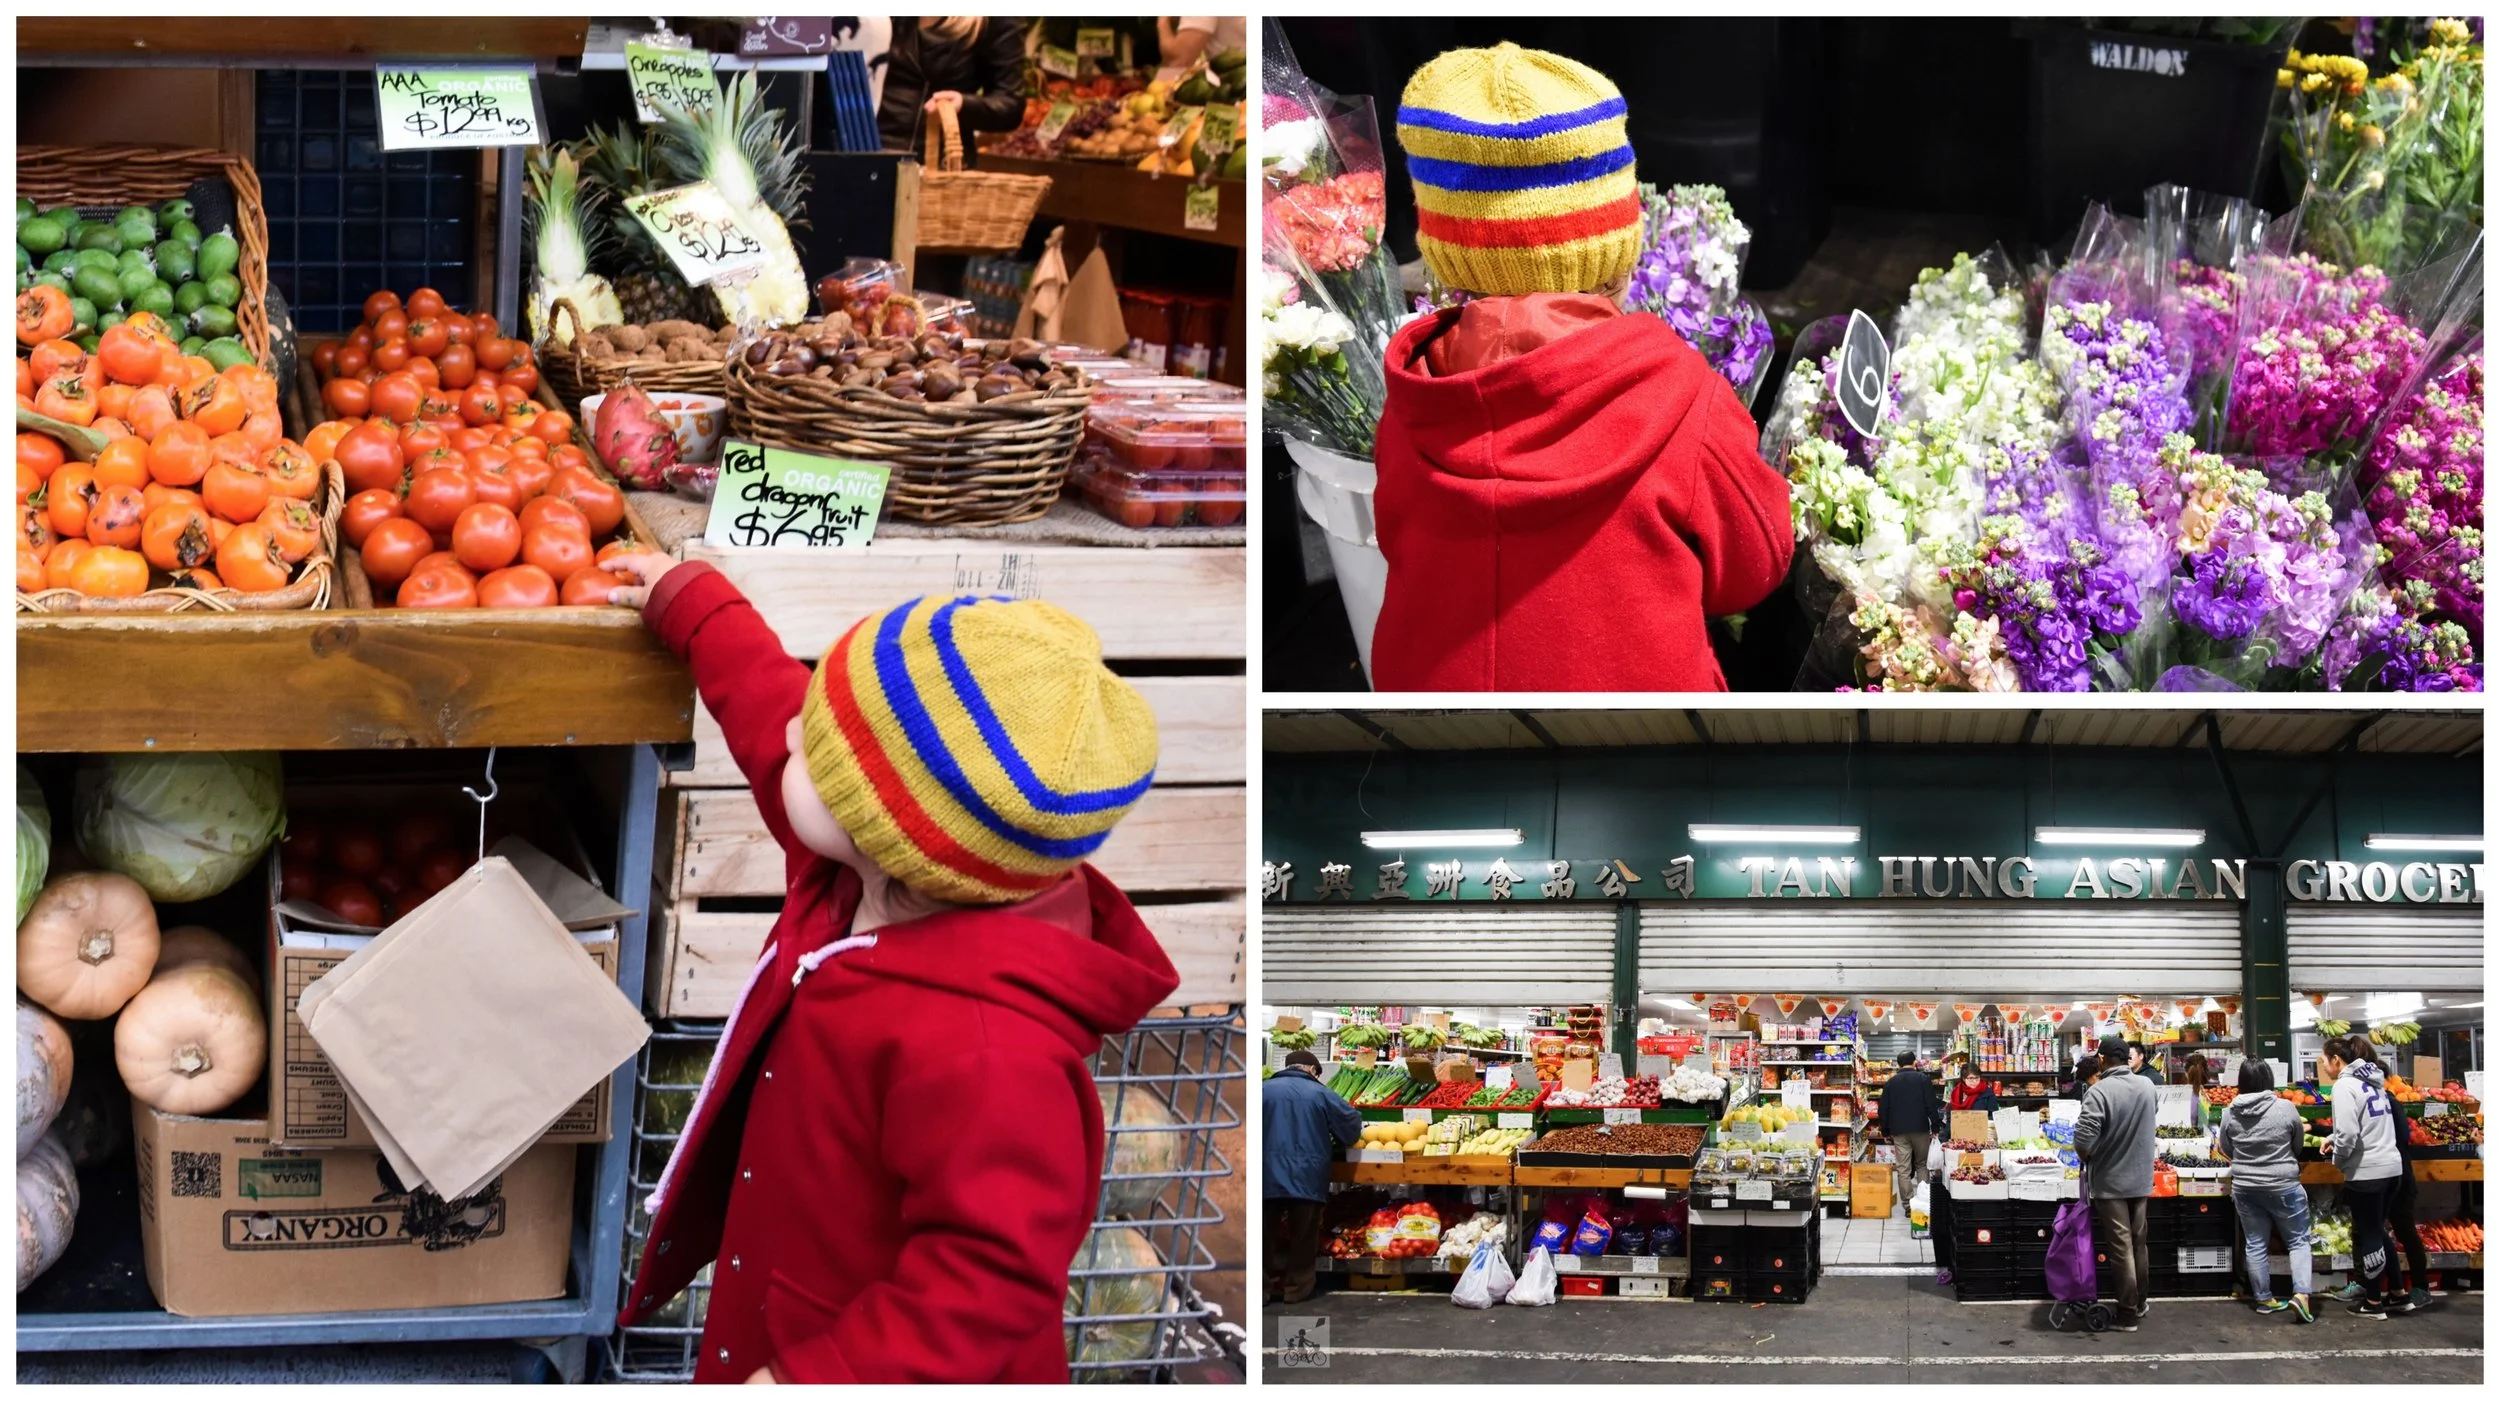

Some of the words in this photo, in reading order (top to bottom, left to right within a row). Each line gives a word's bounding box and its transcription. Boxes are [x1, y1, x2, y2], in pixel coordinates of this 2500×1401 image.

[2090, 42, 2188, 77] WALDON
[381, 72, 427, 92] AAA
[438, 81, 527, 92] ORGANIC
[411, 90, 497, 109] Tomato
[1847, 344, 1881, 408] 6
[725, 443, 765, 474] red
[783, 469, 883, 500] ORGANIC
[840, 470, 881, 482] certified
[1740, 856, 1855, 898] TAN
[1878, 856, 2038, 898] HUNG
[2064, 856, 2247, 899] ASIAN
[272, 1172, 319, 1183] NASAA
[240, 1214, 389, 1241] ORGANK
[2363, 1246, 2386, 1270] NIK
